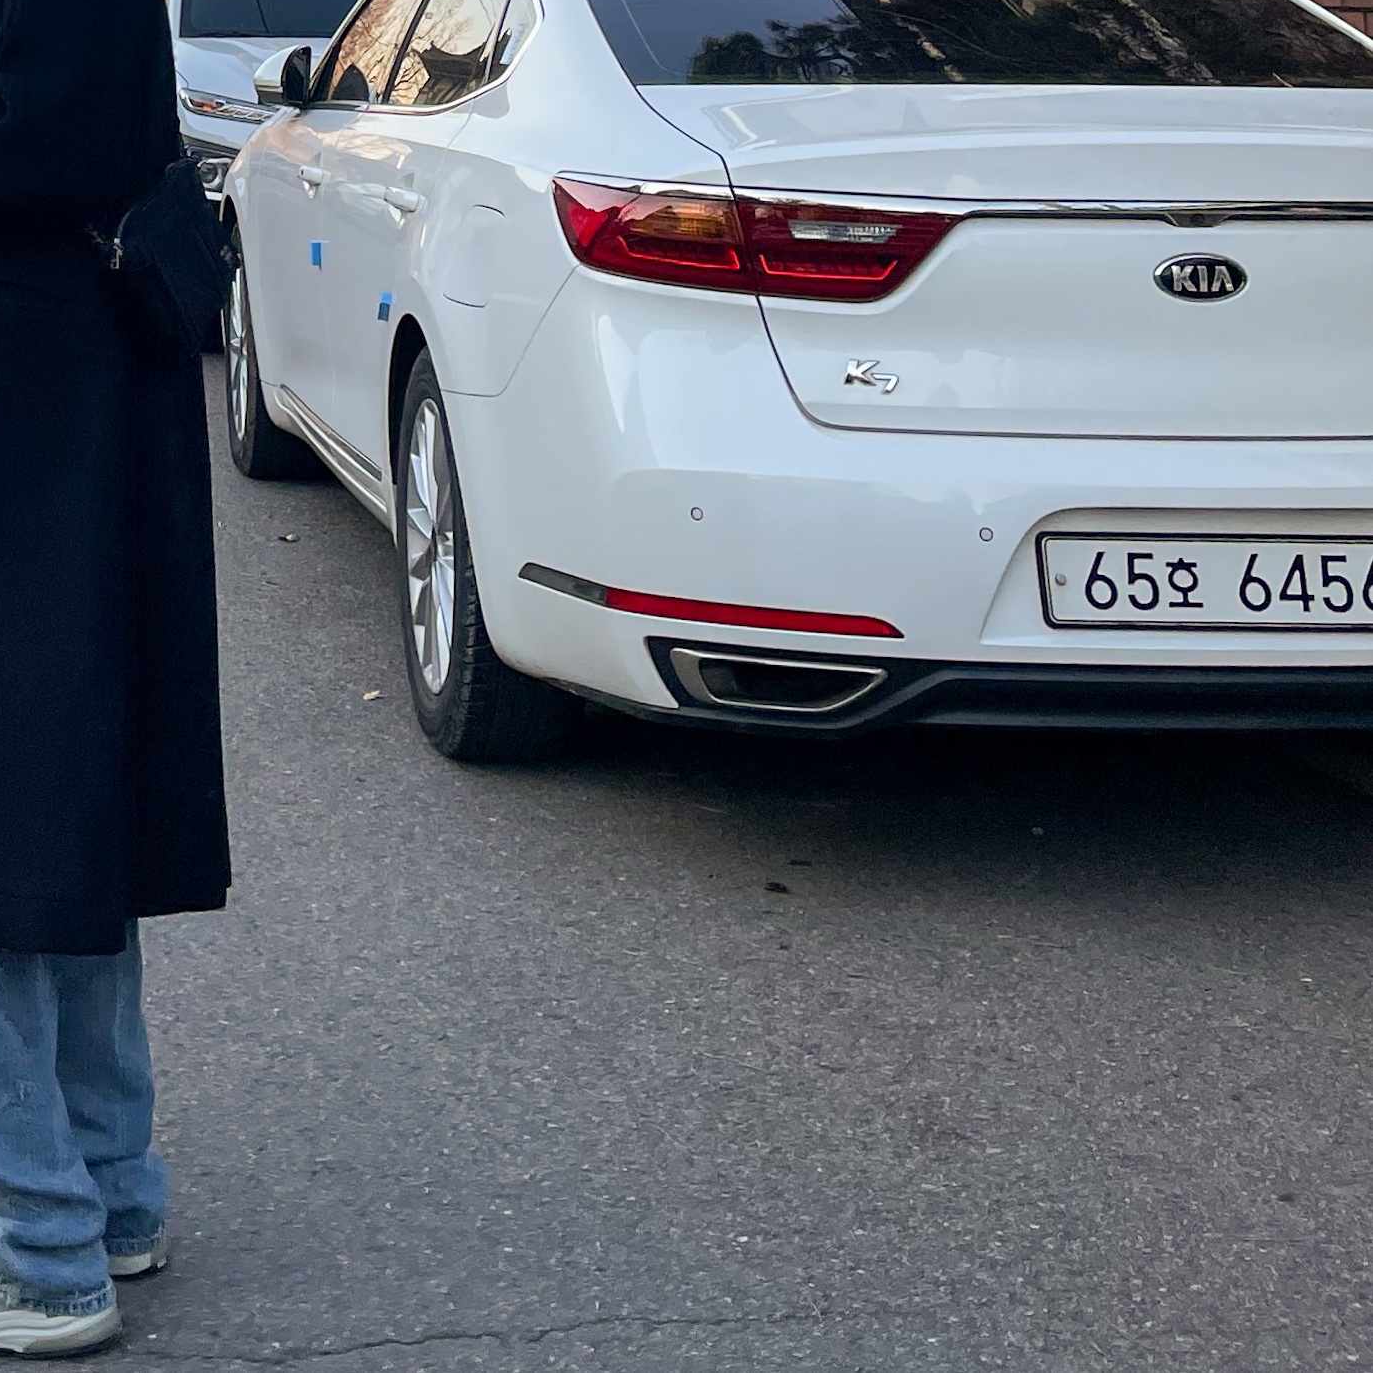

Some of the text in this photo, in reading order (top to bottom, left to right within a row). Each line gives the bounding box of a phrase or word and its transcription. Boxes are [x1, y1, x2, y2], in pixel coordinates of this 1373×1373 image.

[1170, 264, 1235, 293] KIA
[842, 358, 900, 395] K7
[1084, 550, 1205, 611] 65호
